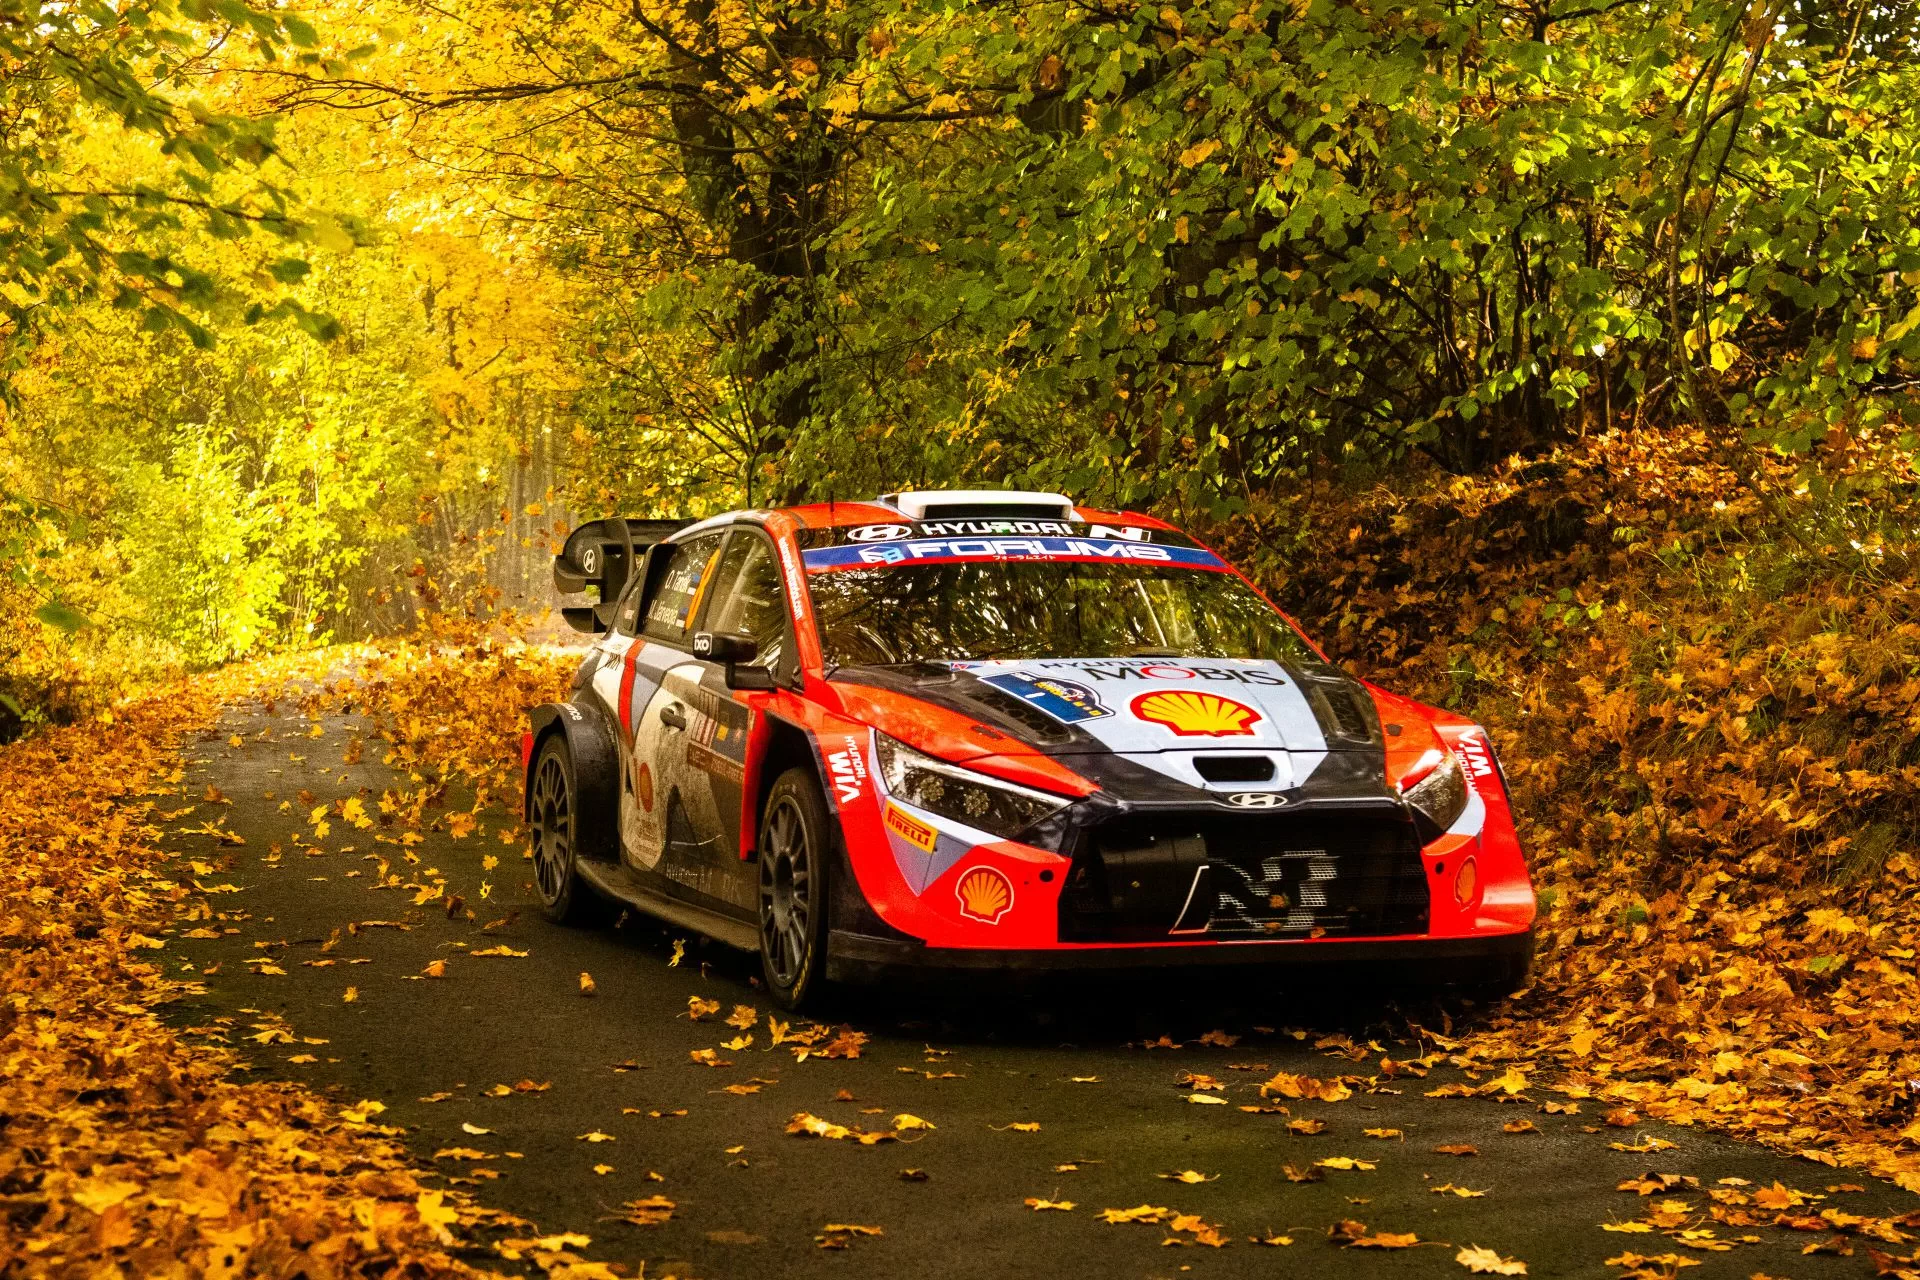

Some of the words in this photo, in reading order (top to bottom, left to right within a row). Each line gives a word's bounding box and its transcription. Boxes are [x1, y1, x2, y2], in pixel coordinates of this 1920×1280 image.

[907, 539, 1172, 562] FORUM8
[1081, 665, 1287, 686] MOBIS
[843, 735, 867, 779] HYUNDAI
[886, 806, 931, 847] PIRELLI
